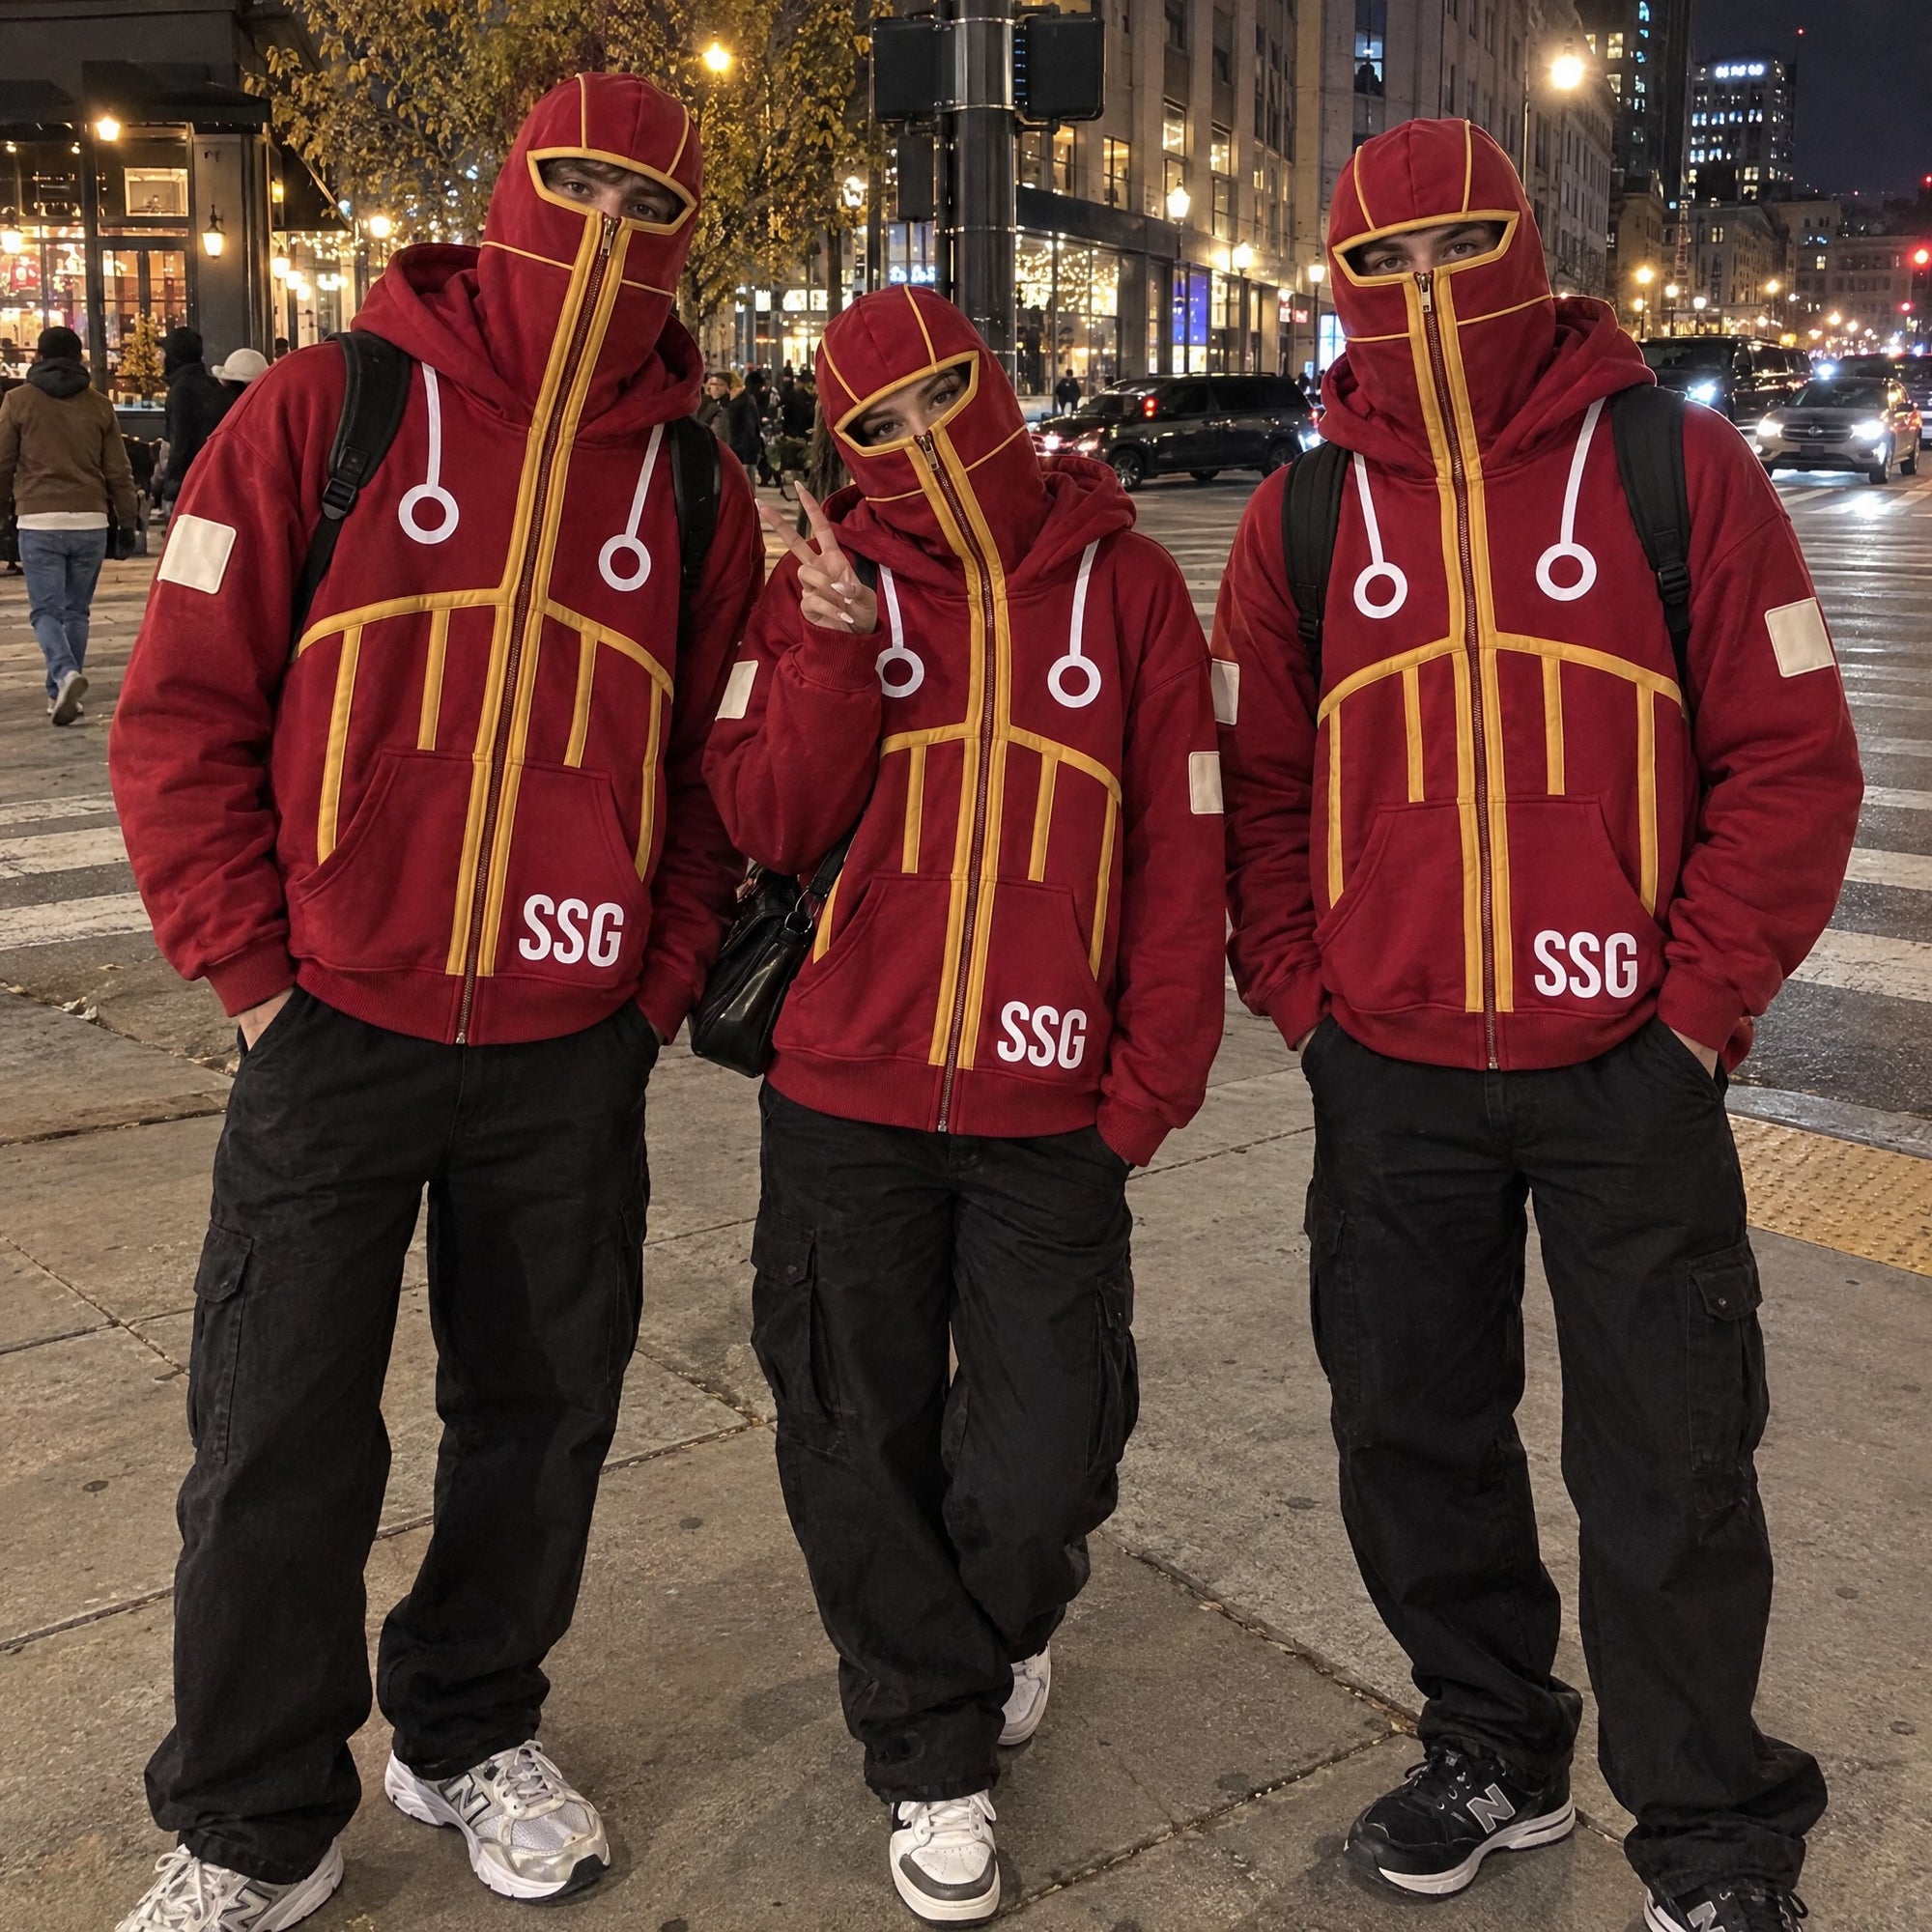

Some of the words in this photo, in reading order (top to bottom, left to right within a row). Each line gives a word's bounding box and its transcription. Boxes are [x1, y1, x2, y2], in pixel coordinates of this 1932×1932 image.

[519, 894, 624, 967] SSG
[1534, 929, 1637, 999] SSG
[997, 1001, 1087, 1069] SSG
[440, 1773, 491, 1825] N
[1466, 1782, 1516, 1834] N
